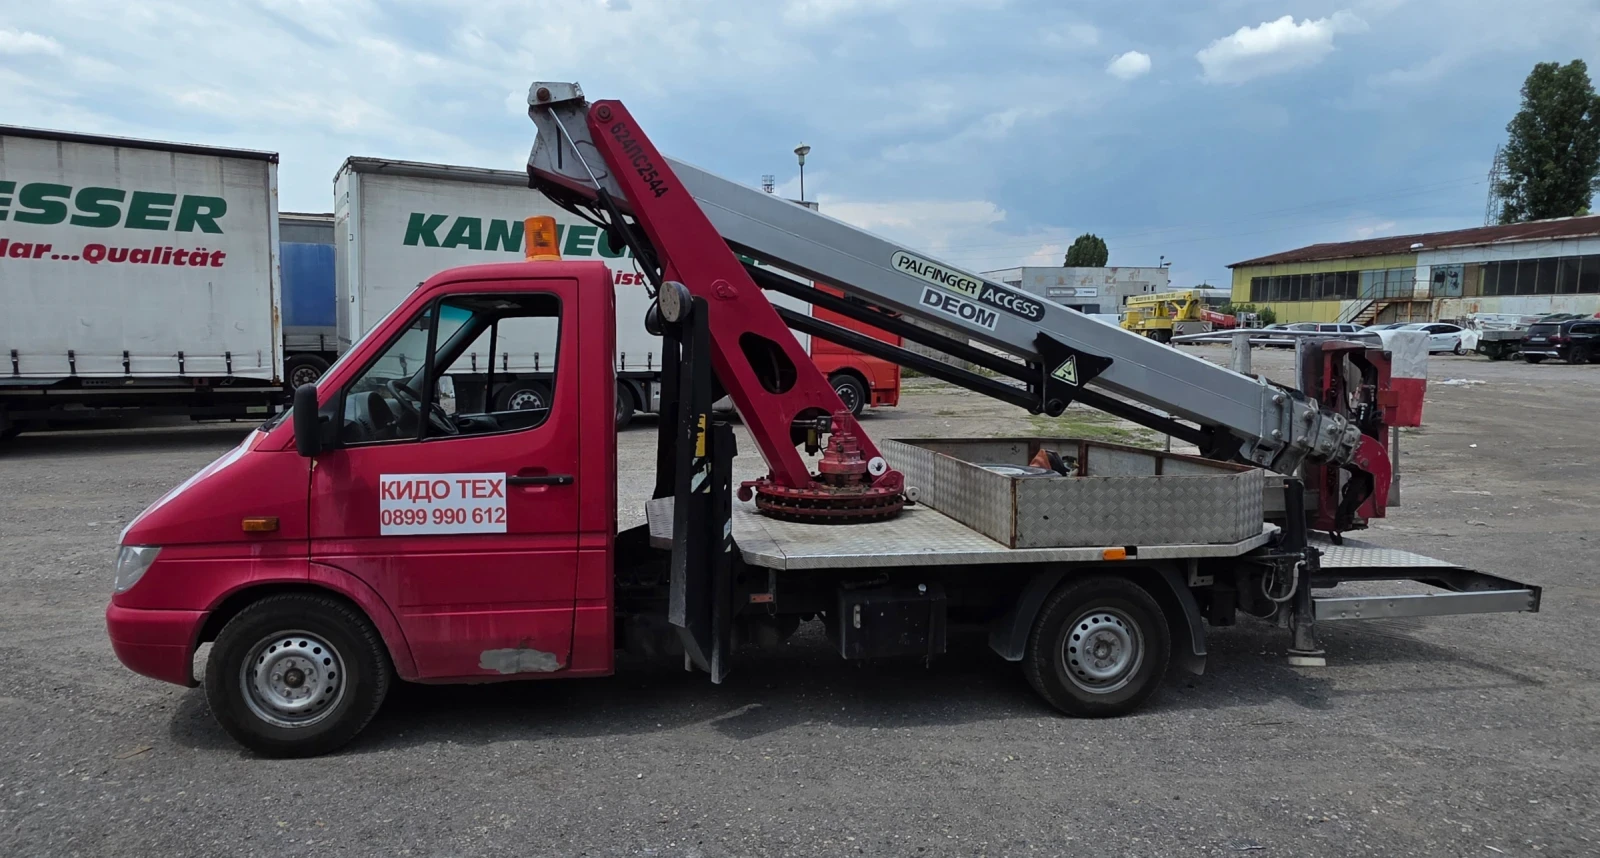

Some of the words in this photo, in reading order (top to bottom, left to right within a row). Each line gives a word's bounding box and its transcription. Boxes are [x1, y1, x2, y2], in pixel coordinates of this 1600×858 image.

[614, 270, 645, 285] ist
[898, 255, 977, 295] PALFINGER
[982, 288, 1040, 318] ACCESS
[922, 288, 997, 328] DEOM
[381, 479, 450, 503] КИДО
[455, 479, 504, 499] ТЕХ
[381, 509, 427, 526] 0899
[432, 508, 467, 525] 990
[471, 507, 506, 524] 612
